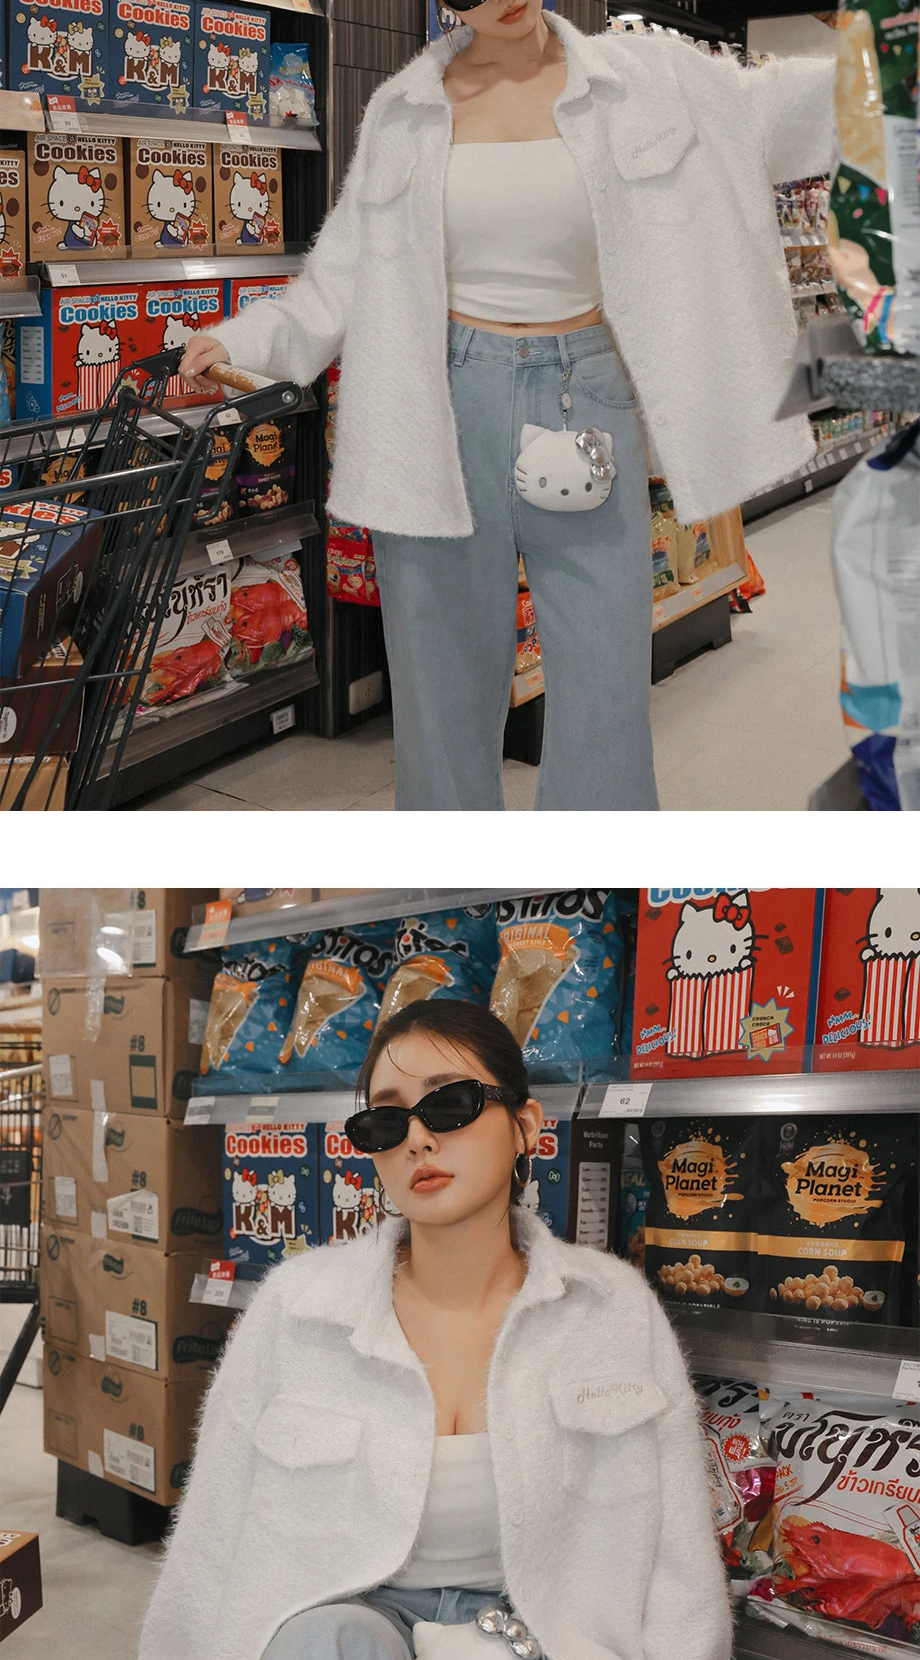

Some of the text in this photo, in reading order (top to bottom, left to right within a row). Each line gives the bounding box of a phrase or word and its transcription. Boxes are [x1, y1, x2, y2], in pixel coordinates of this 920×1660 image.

[77, 136, 116, 145] HELLO KITTY
[36, 143, 117, 163] Cookies
[100, 293, 138, 303] HELLO KITTY
[60, 304, 138, 325] Cookies
[822, 1013, 872, 1045] DELICIOUS!
[618, 1097, 631, 1106] 62
[226, 1134, 306, 1156] Cookies
[670, 1158, 715, 1176] Magi
[804, 1160, 859, 1183] Magi
[665, 1174, 718, 1192] Planet
[794, 1178, 863, 1198] Planet
[668, 1237, 687, 1247] CORN
[797, 1246, 848, 1258] CORN SOUP
